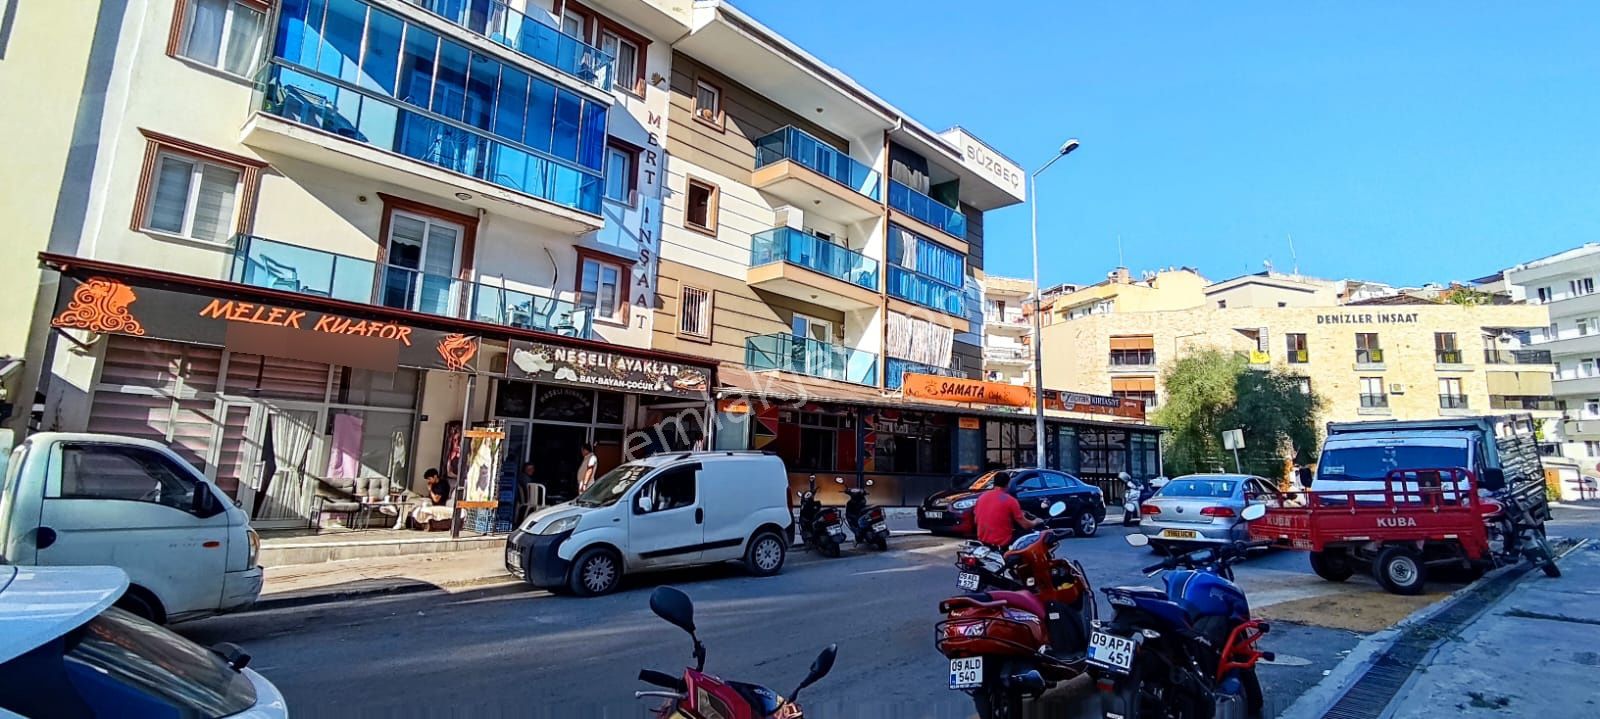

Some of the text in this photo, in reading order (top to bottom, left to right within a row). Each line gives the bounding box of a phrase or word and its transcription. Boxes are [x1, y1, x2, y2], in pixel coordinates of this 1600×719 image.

[644, 111, 661, 186] MERT
[966, 145, 1019, 190] SÜZGEÇ
[199, 299, 413, 347] MELEK KUAFÖR
[1316, 311, 1419, 326] DENİZLER İNŞAAT
[555, 347, 679, 377] NEŞELİ AYAKLAR
[579, 375, 655, 392] BAY-BAYAN-ÇOCUK
[940, 382, 985, 399] ŞAMATA
[1266, 514, 1292, 527] KUBA
[1376, 516, 1417, 529] KUBA
[1092, 632, 1131, 654] 09 APA
[951, 658, 981, 672] 09 ALD
[1108, 650, 1130, 667] 451
[959, 670, 976, 683] 540
